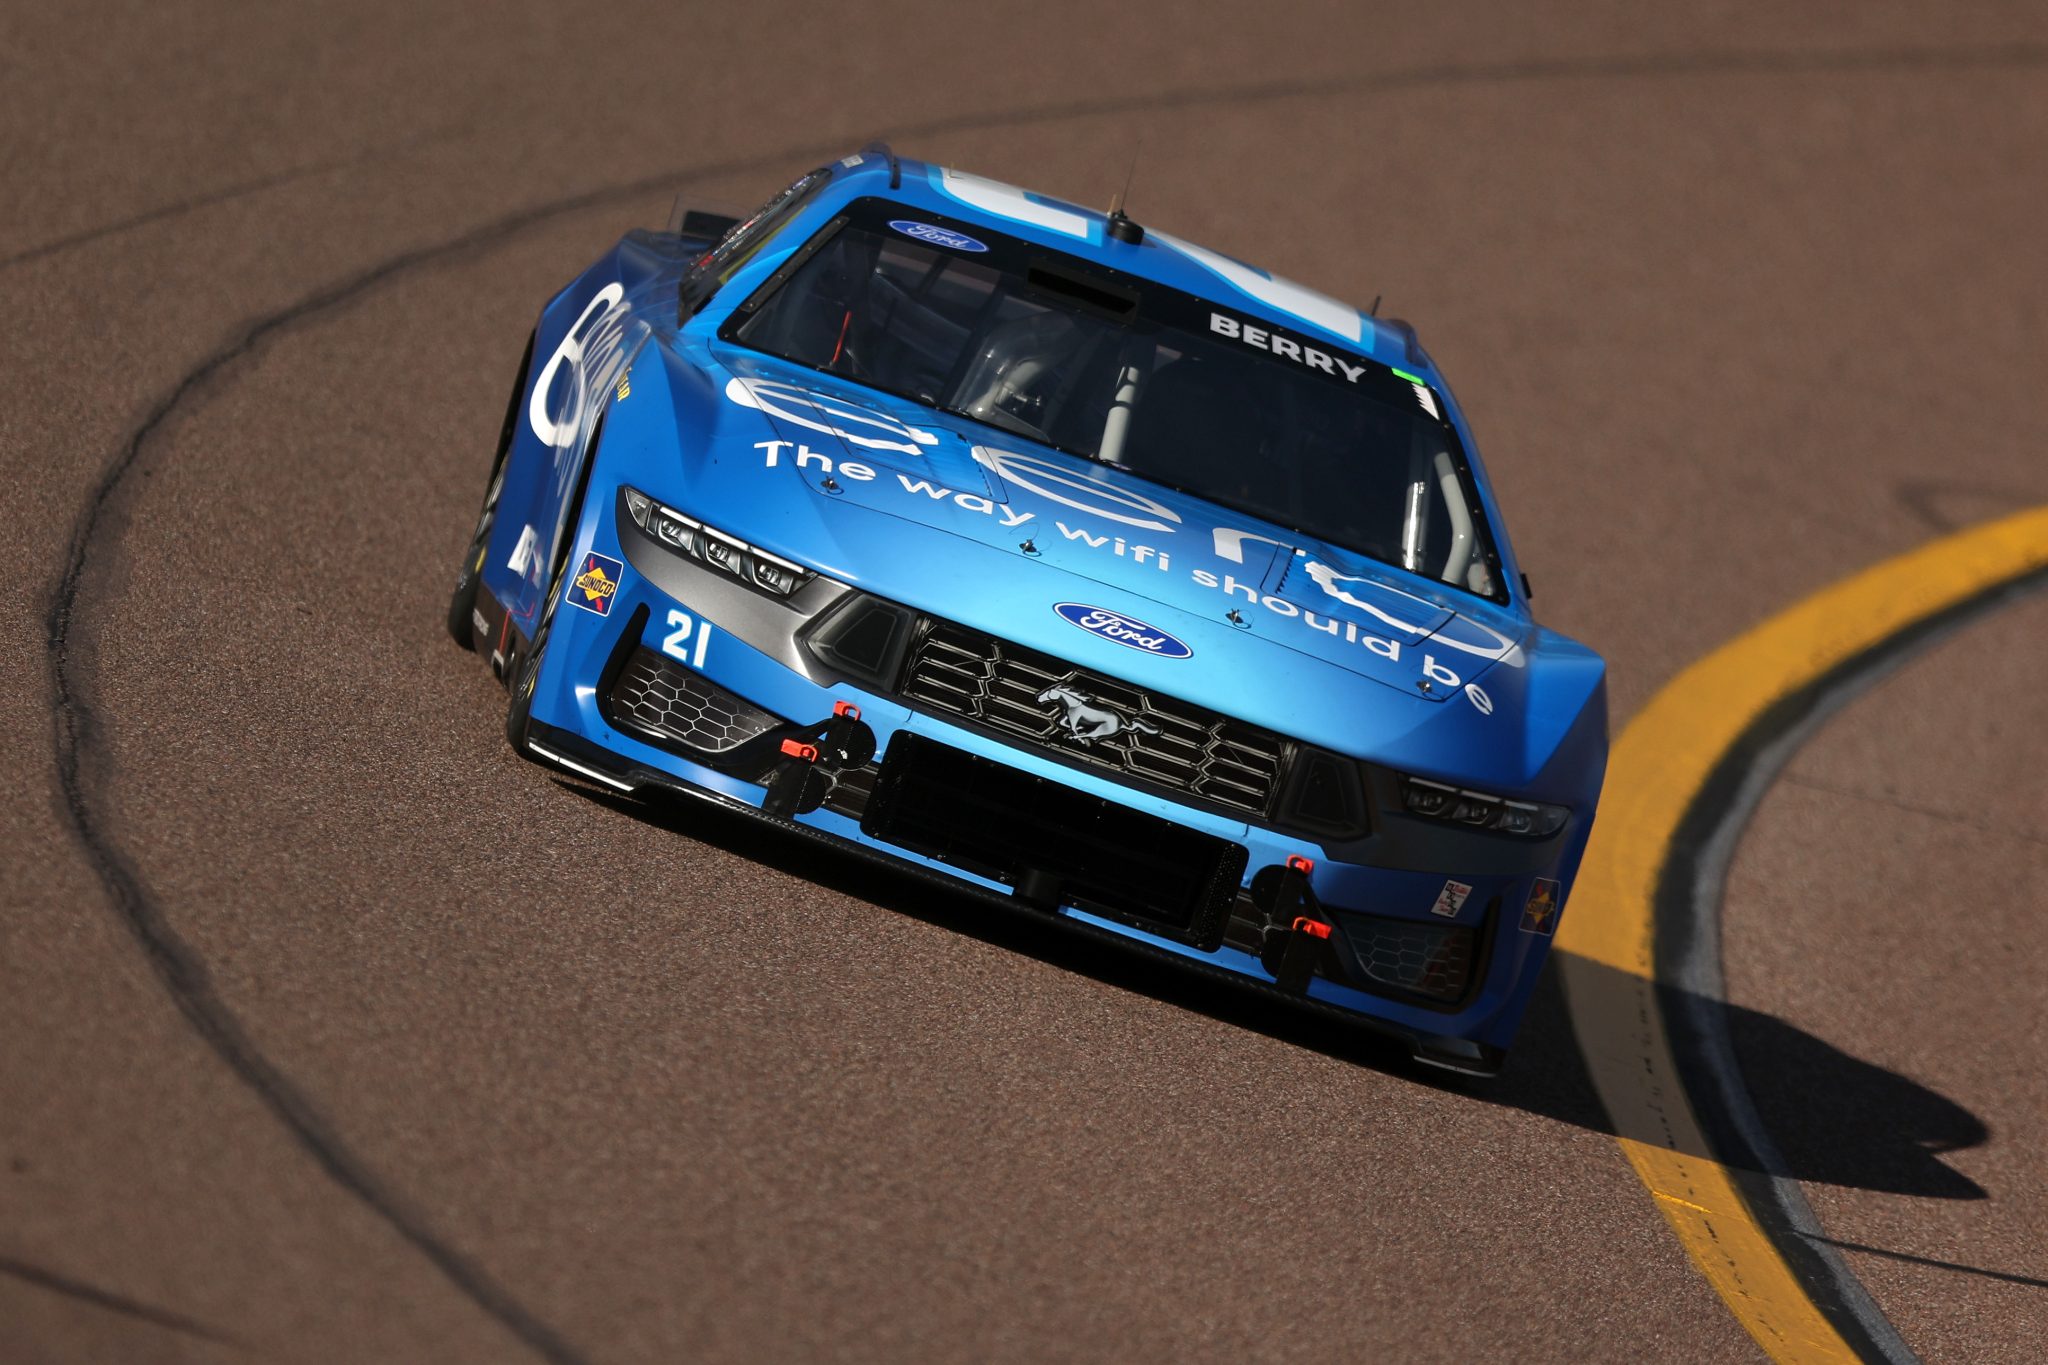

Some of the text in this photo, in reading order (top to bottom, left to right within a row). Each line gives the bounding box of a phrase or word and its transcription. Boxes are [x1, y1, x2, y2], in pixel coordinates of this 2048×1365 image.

[907, 225, 969, 248] Ford
[1210, 312, 1367, 383] BERRY
[578, 574, 614, 595] SUNOCO
[754, 440, 1494, 716] The way wifi should be
[662, 608, 712, 669] 21
[1080, 611, 1166, 650] Ford
